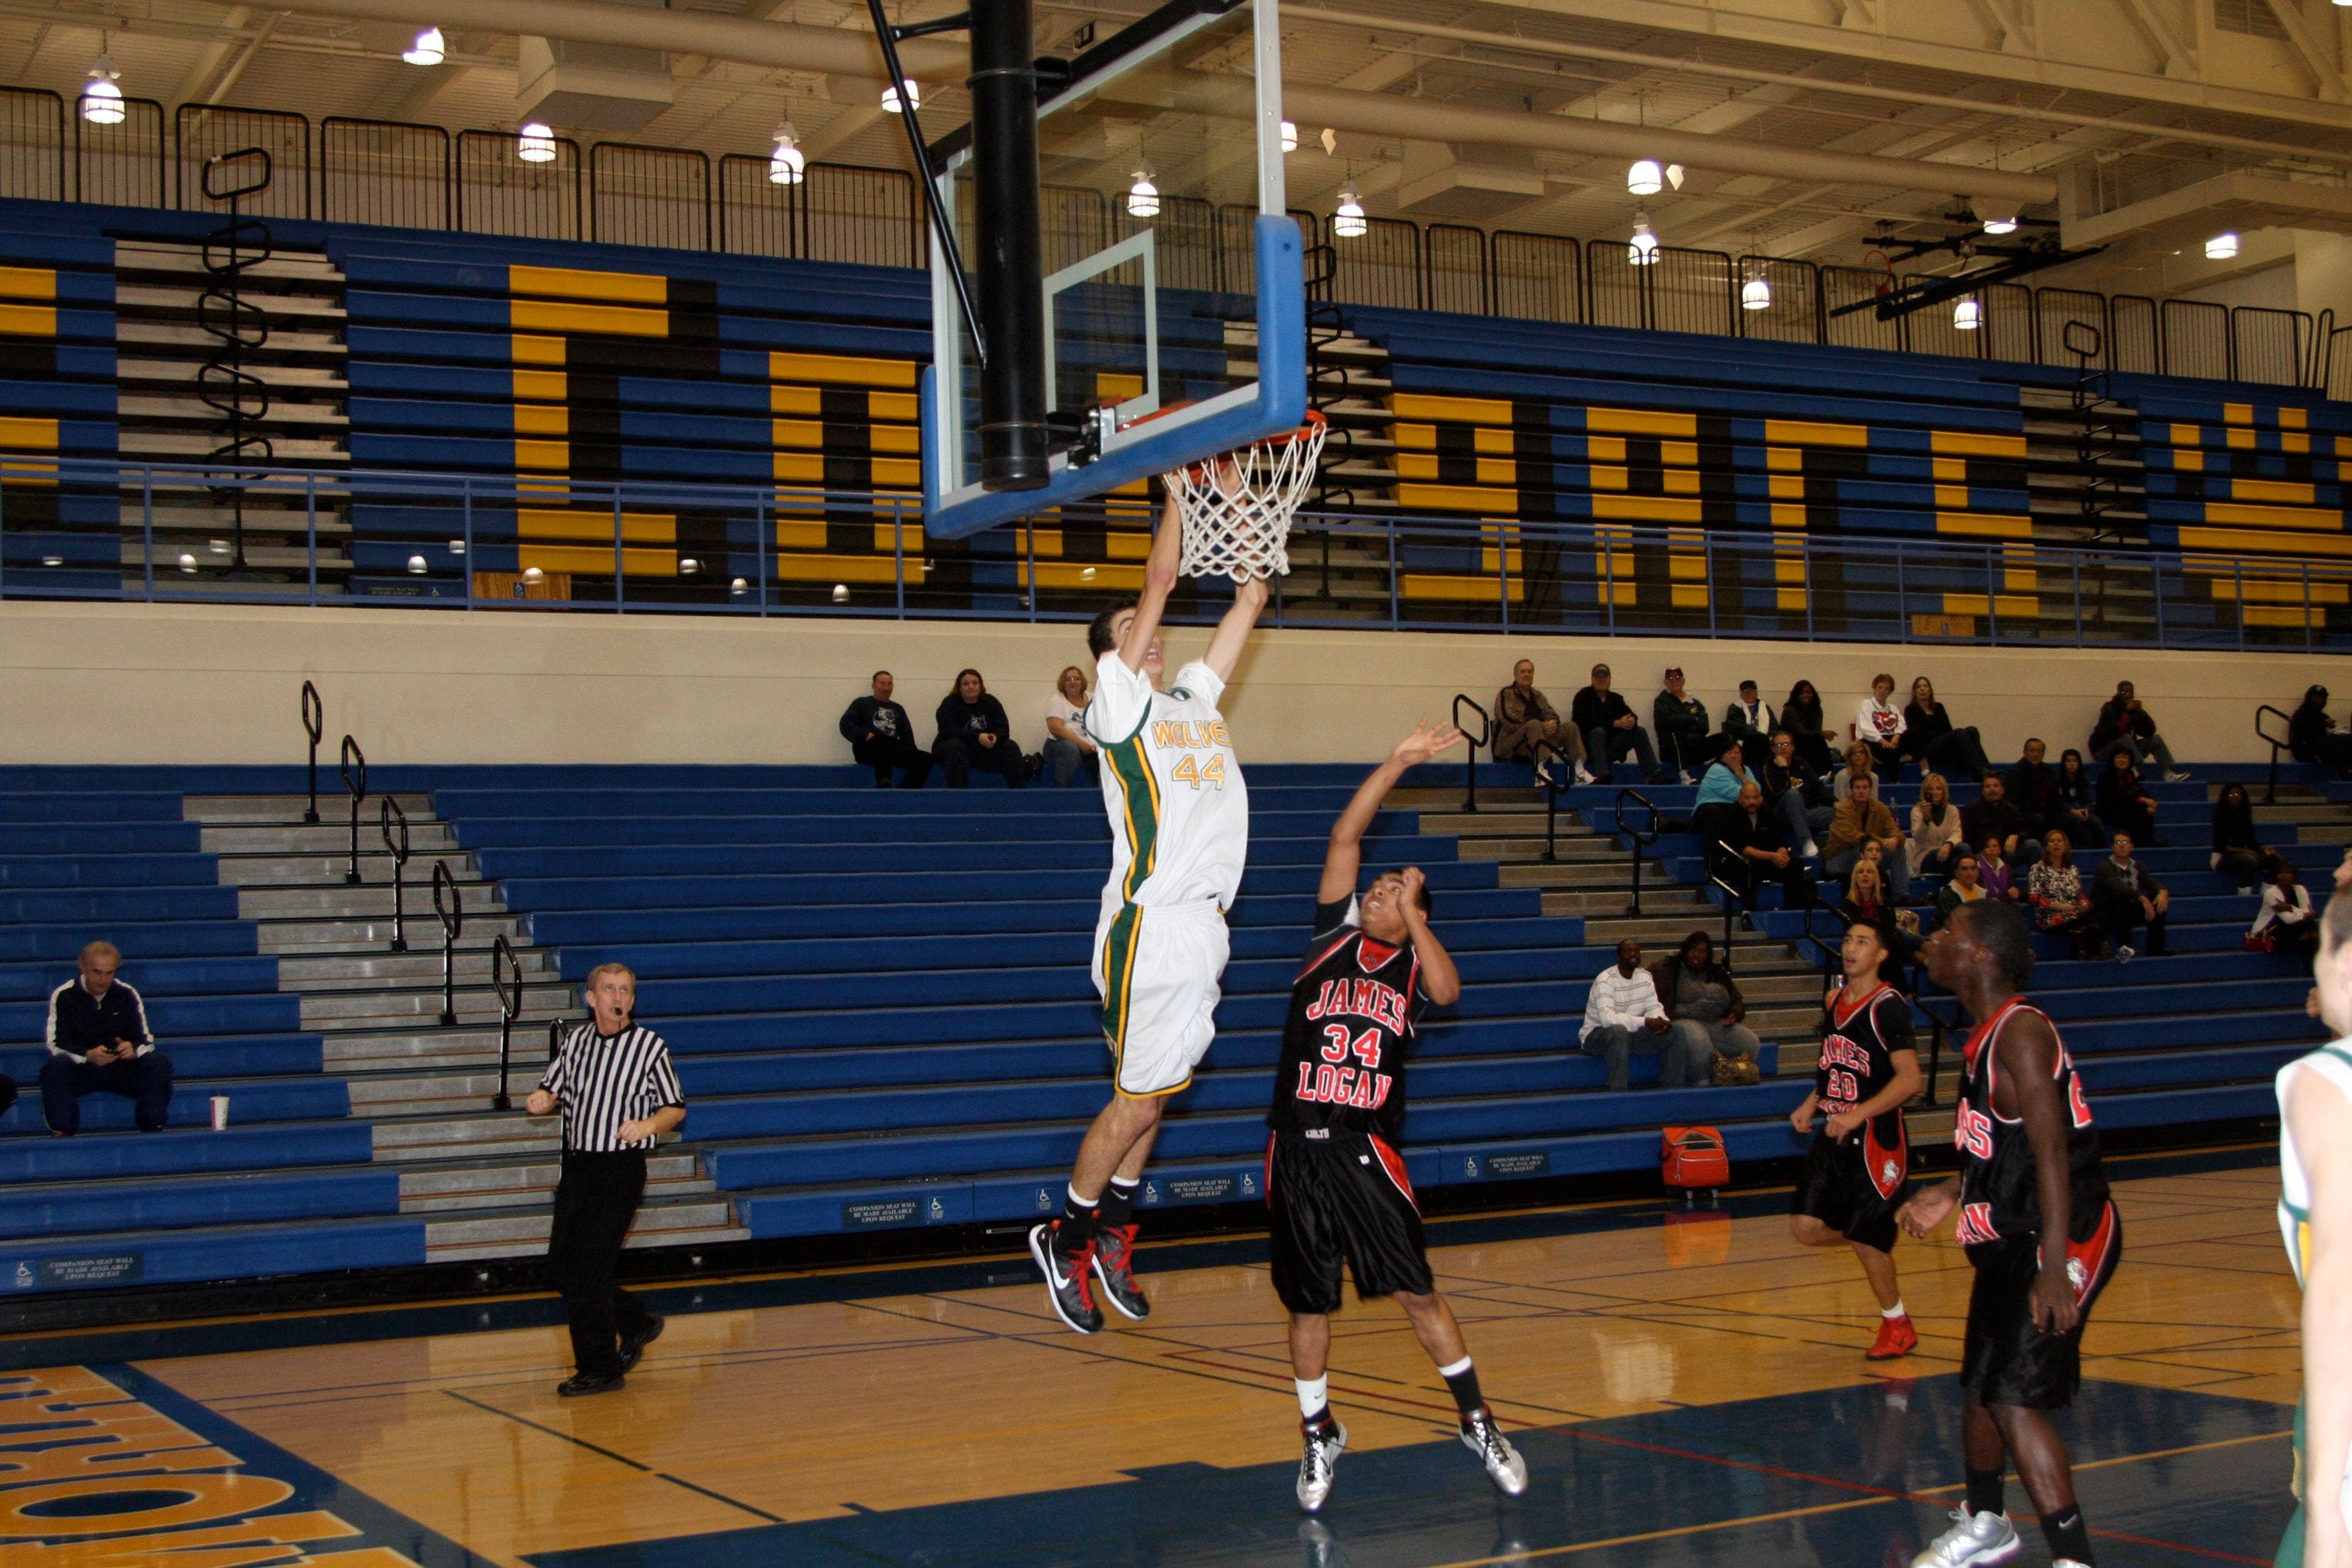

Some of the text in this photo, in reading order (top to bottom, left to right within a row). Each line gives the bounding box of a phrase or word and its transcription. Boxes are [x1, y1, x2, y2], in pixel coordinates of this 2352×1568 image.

[1171, 754, 1225, 790] 44
[1306, 978, 1407, 1037] JAMES
[1321, 1024, 1382, 1068] 34
[1296, 1062, 1392, 1110] LOGAN
[1828, 1068, 1858, 1101] 20
